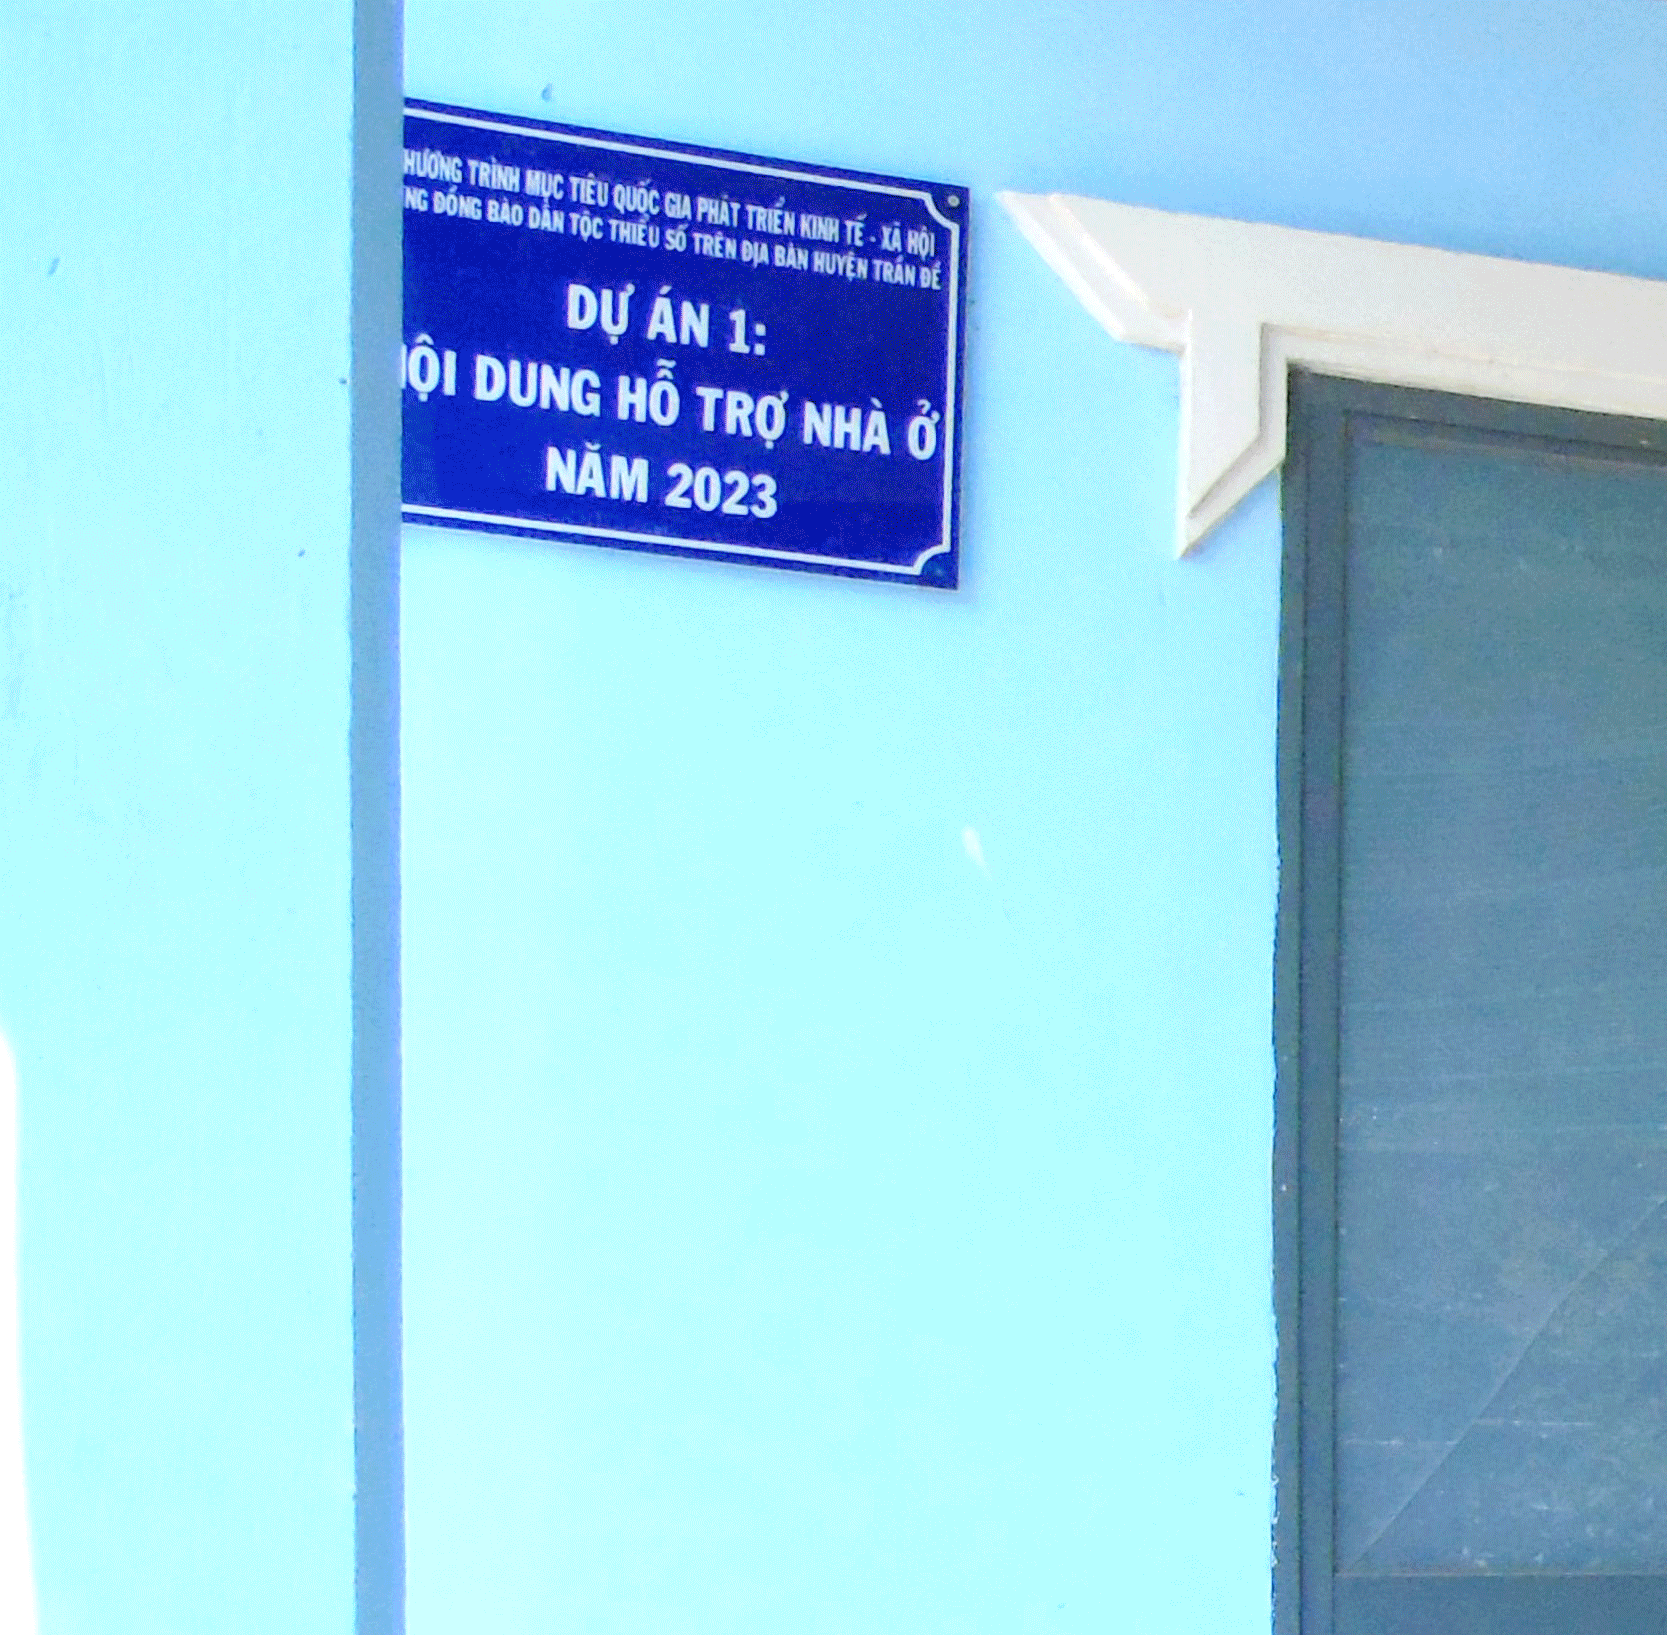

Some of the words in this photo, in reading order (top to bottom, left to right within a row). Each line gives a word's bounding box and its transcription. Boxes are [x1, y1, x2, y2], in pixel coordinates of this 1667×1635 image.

[404, 147, 463, 183] HƯƠNG
[568, 173, 609, 208] TIÊU
[612, 179, 660, 215] QUỐC
[664, 191, 692, 221] GIA
[800, 213, 840, 243] KINH
[907, 225, 936, 262] HỘI
[568, 209, 604, 243] TỘC
[664, 223, 690, 253] SỐ
[692, 231, 738, 261] TRÊN
[813, 250, 869, 282] HUYỆN
[567, 283, 636, 345] DỰ
[646, 285, 710, 348] ÁN
[728, 307, 767, 356] 1:
[400, 332, 457, 402] ỘI
[474, 353, 601, 417] DUNG
[616, 358, 681, 427] HỖ
[695, 386, 790, 450] TRỢ
[802, 397, 892, 456] NHÀ
[907, 398, 941, 461] Ở
[546, 442, 649, 503] NĂM
[664, 462, 778, 519] 2023
